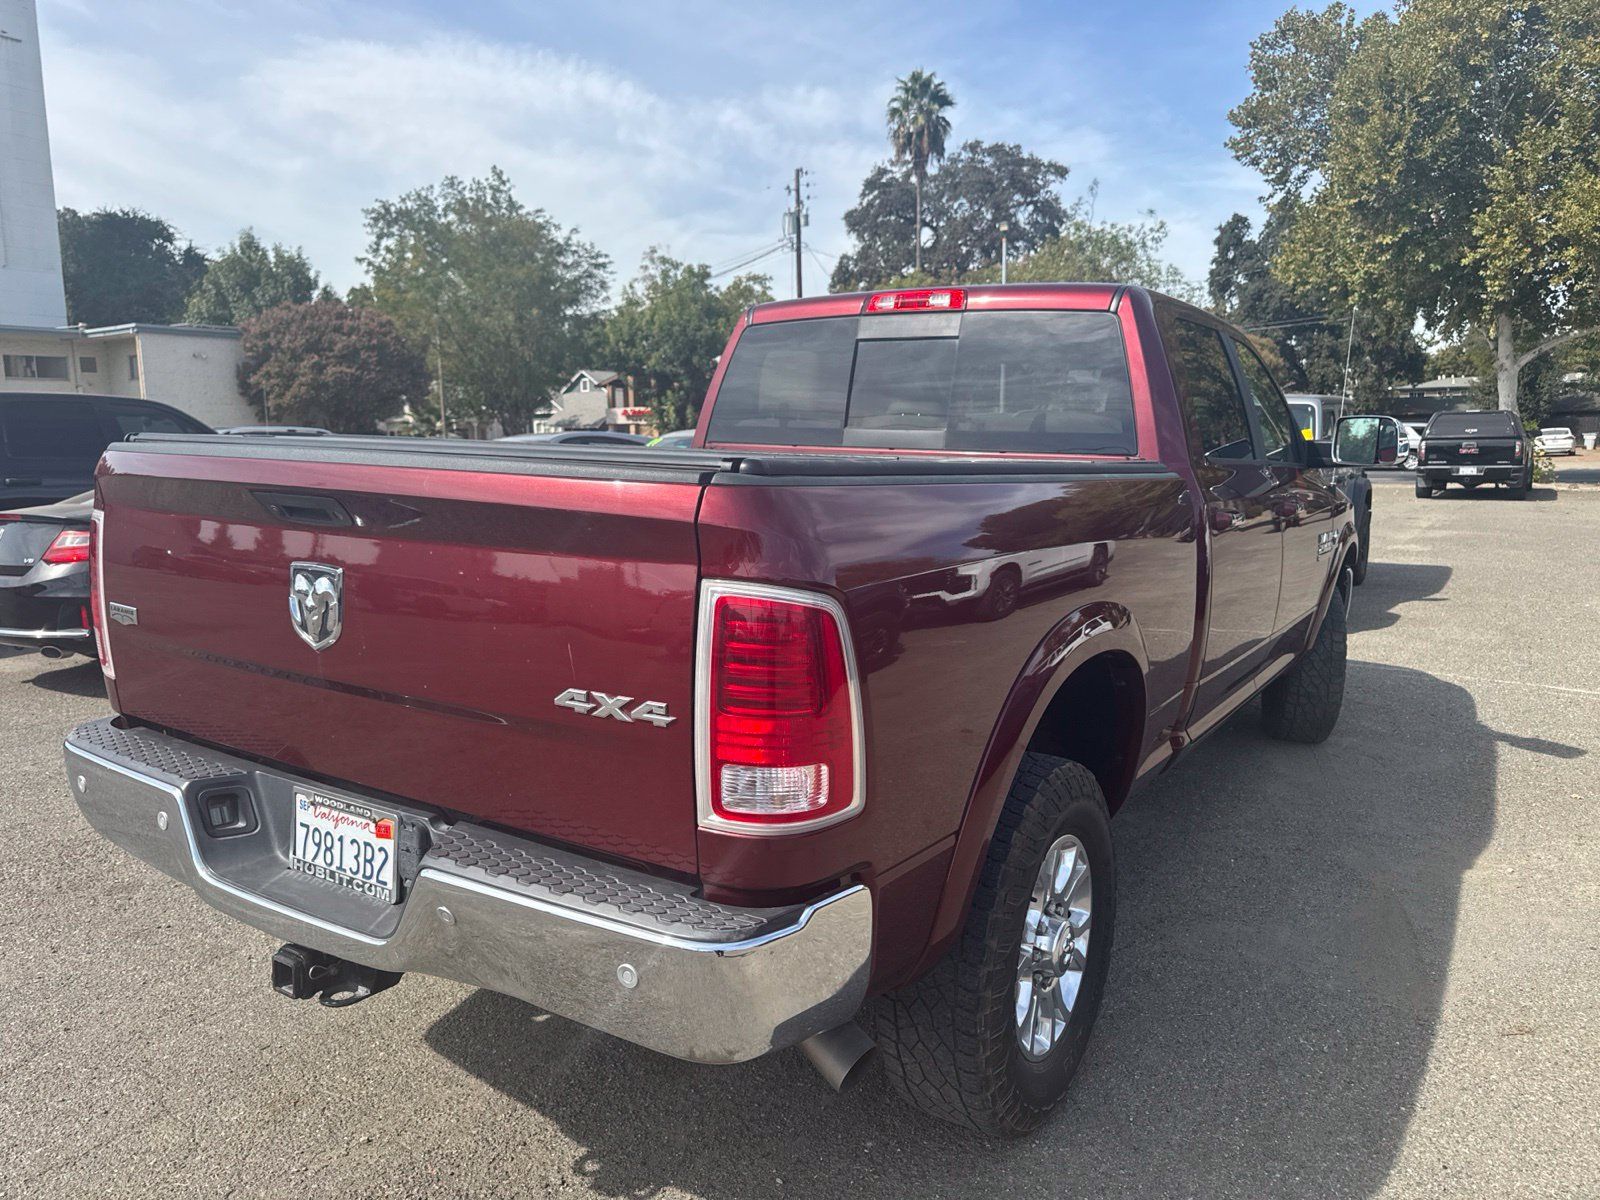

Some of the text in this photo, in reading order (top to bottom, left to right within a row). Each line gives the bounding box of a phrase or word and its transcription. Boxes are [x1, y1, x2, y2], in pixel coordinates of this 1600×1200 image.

[312, 805, 377, 835] California
[313, 794, 371, 818] WOODLAND
[299, 821, 389, 887] 79813B2
[292, 858, 391, 901] HOBLIT.COM
